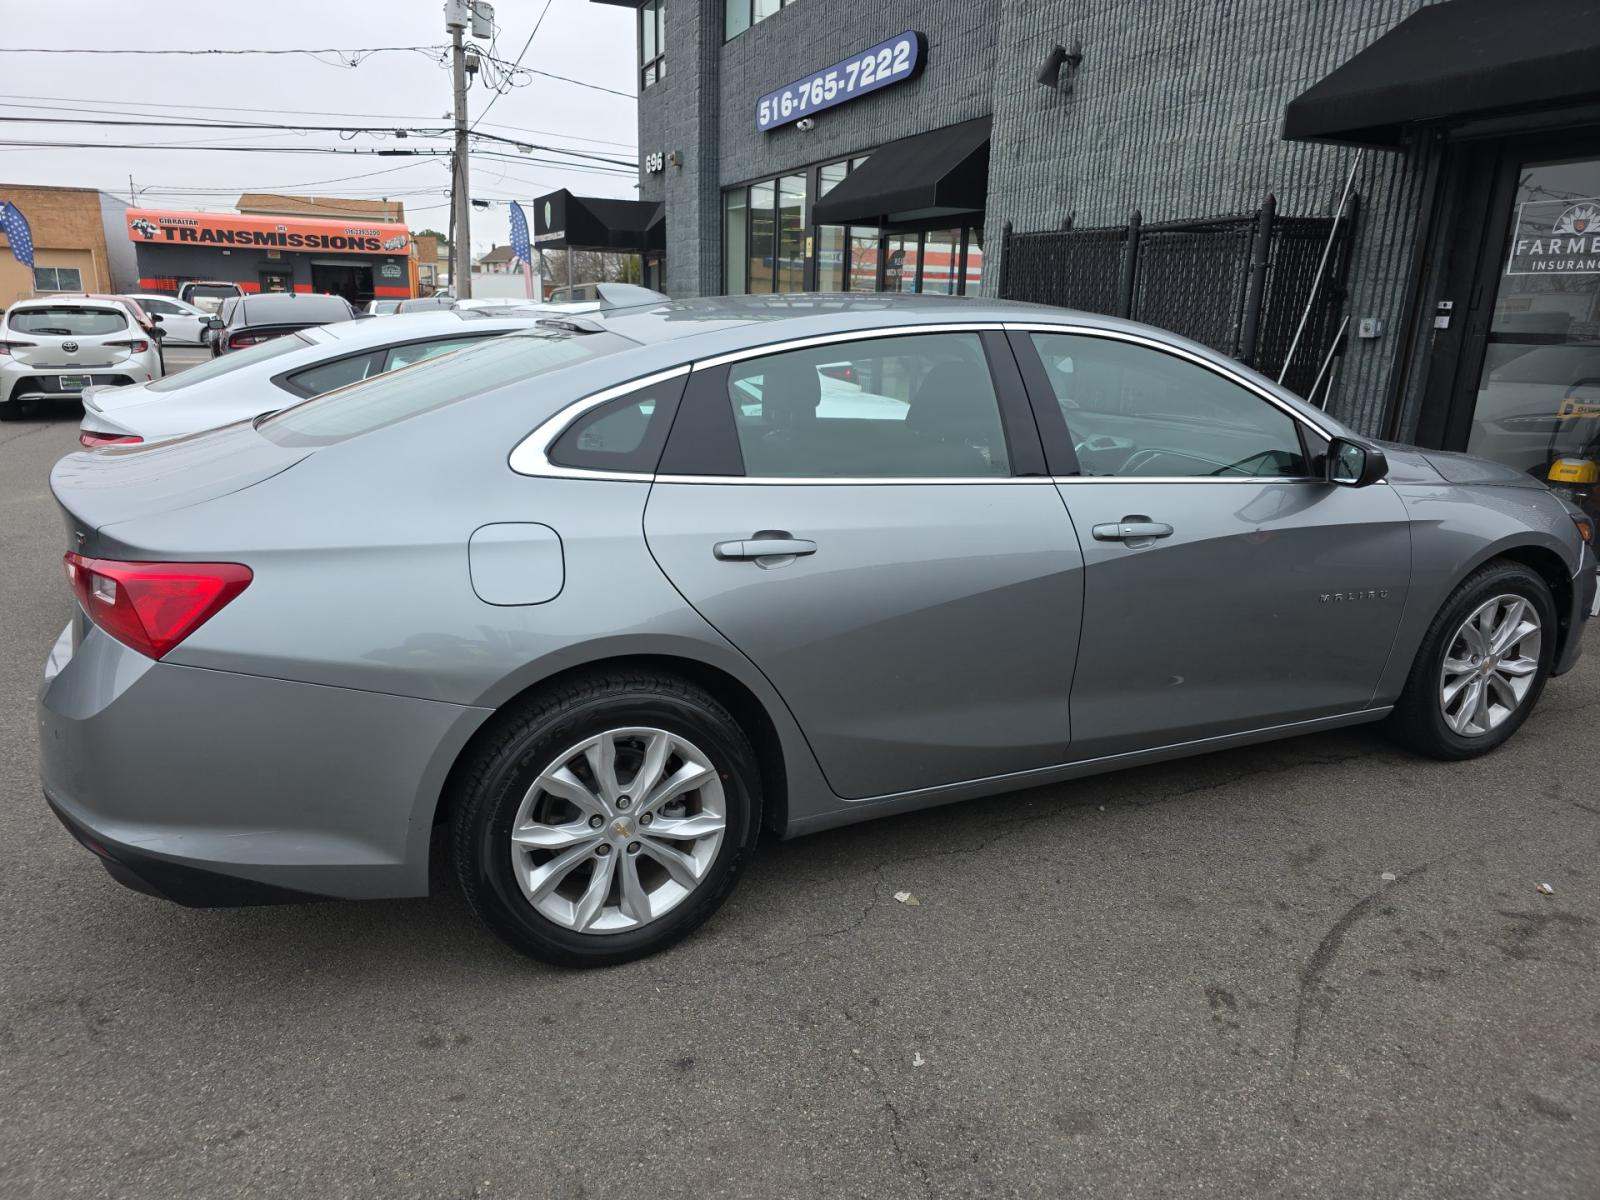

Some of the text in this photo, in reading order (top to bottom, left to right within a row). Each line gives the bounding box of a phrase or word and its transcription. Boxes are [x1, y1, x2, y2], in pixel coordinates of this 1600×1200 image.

[759, 40, 911, 126] 516-765-7222
[646, 152, 662, 174] 696
[160, 226, 381, 251] TRANSMISSIONS
[1320, 590, 1388, 602] MALIBU
